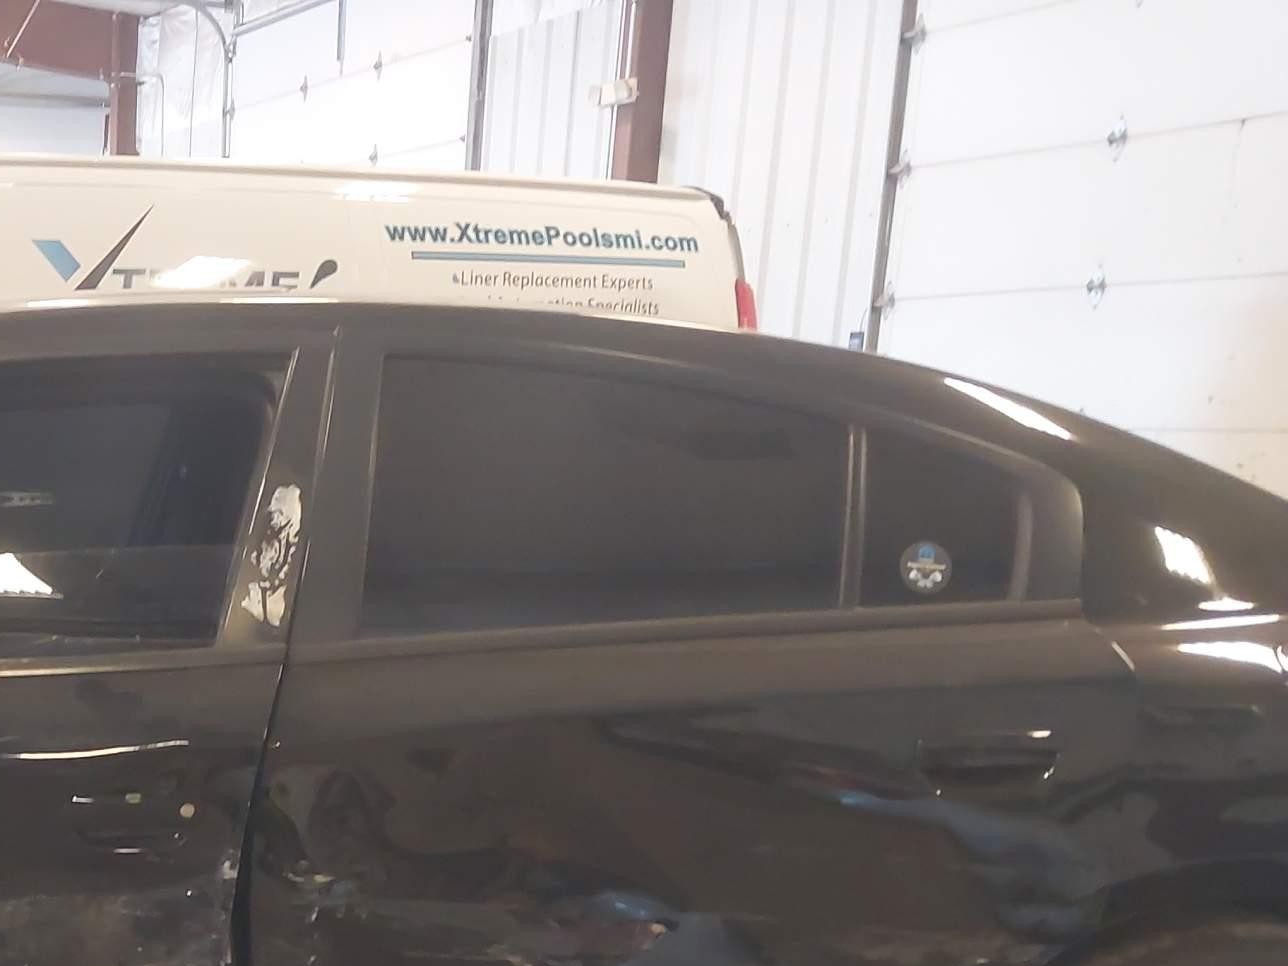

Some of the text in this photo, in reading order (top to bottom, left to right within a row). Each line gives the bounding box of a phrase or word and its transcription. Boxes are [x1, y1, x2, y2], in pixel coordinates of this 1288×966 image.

[384, 222, 699, 252] www.XtremePoolsmi.com
[460, 270, 654, 292] Liner Replacement Experts
